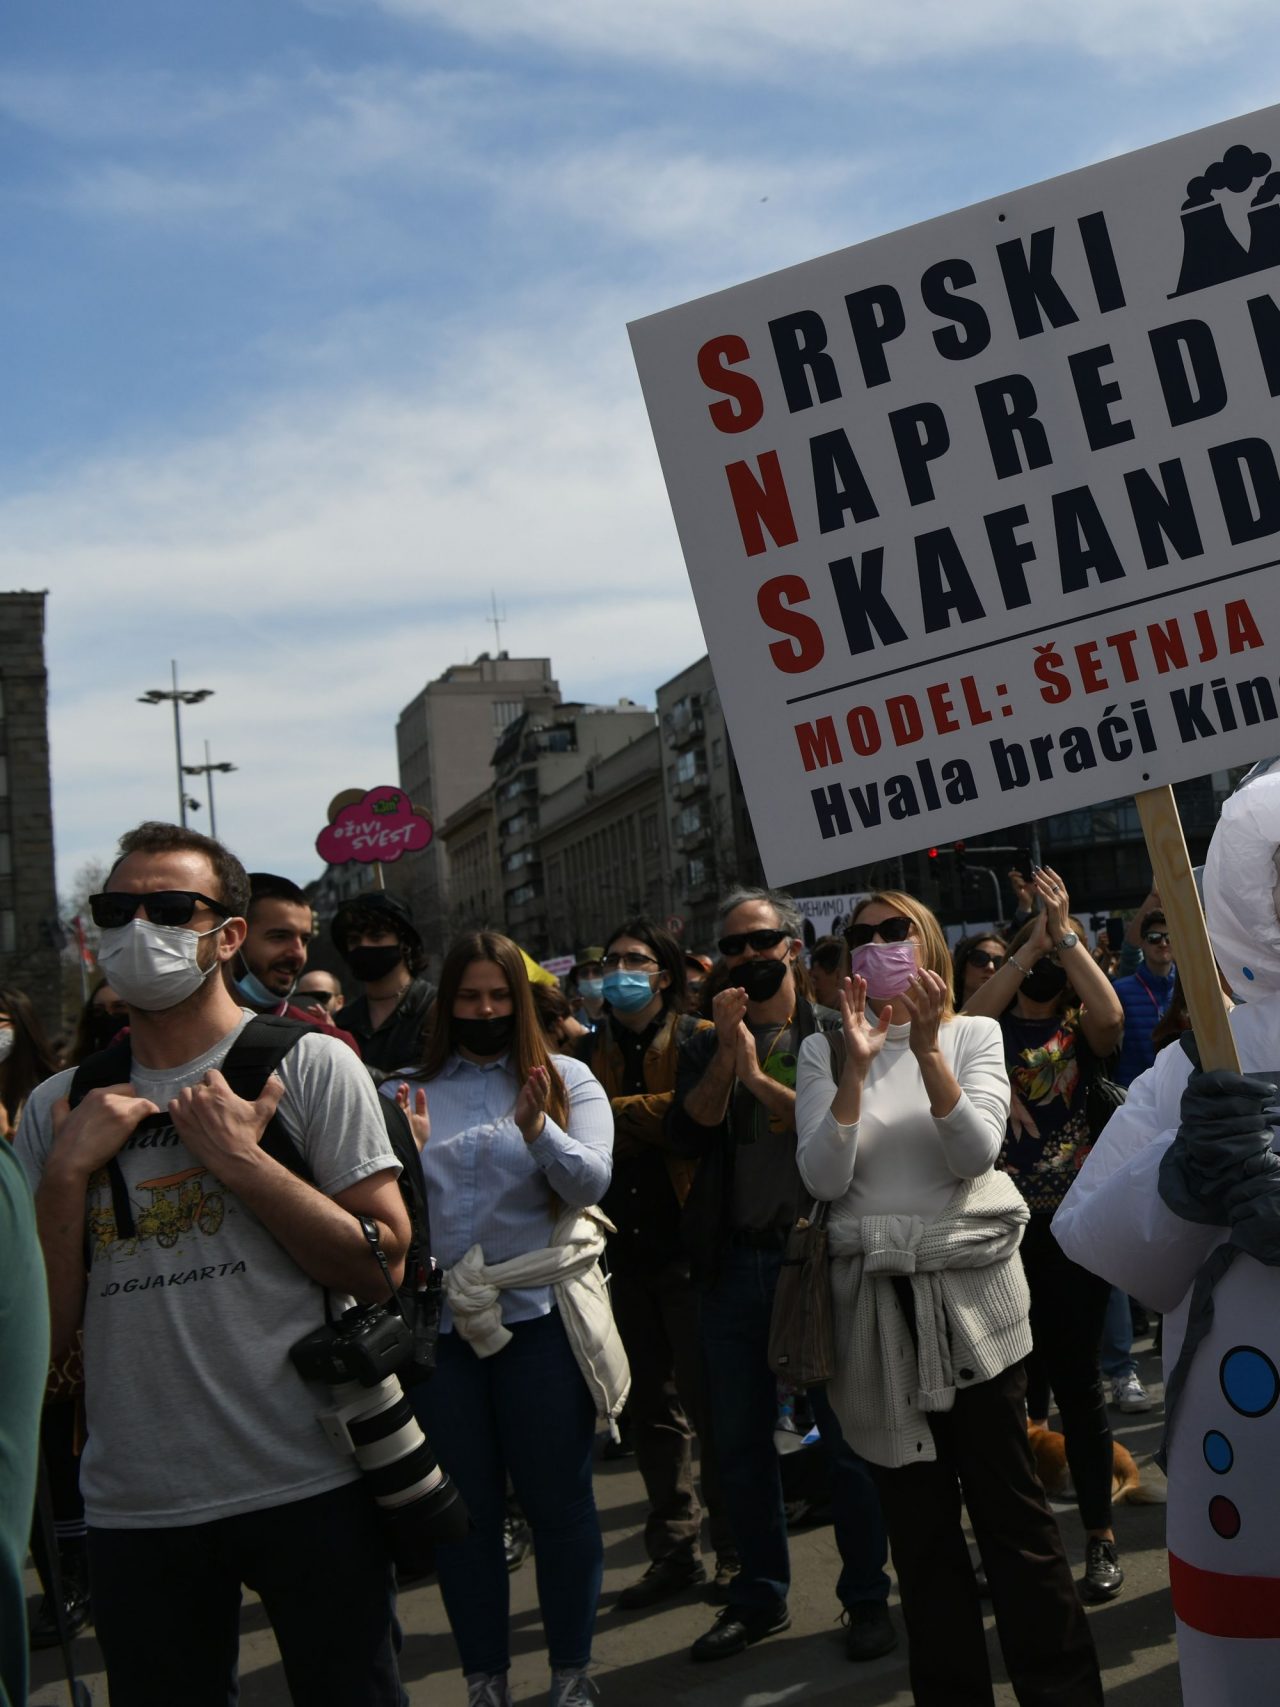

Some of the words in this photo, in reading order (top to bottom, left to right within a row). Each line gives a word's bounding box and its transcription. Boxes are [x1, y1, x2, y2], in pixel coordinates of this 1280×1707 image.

[696, 210, 1127, 435] SRPSKI
[793, 675, 1014, 773] MODEL:
[1031, 598, 1265, 705] ŠETNJA
[810, 757, 979, 841] Hvala
[988, 698, 1158, 793] braći
[333, 820, 382, 839] OŽIVI
[351, 823, 417, 850] SVEST
[99, 1259, 247, 1298] JOGJAKARTA
